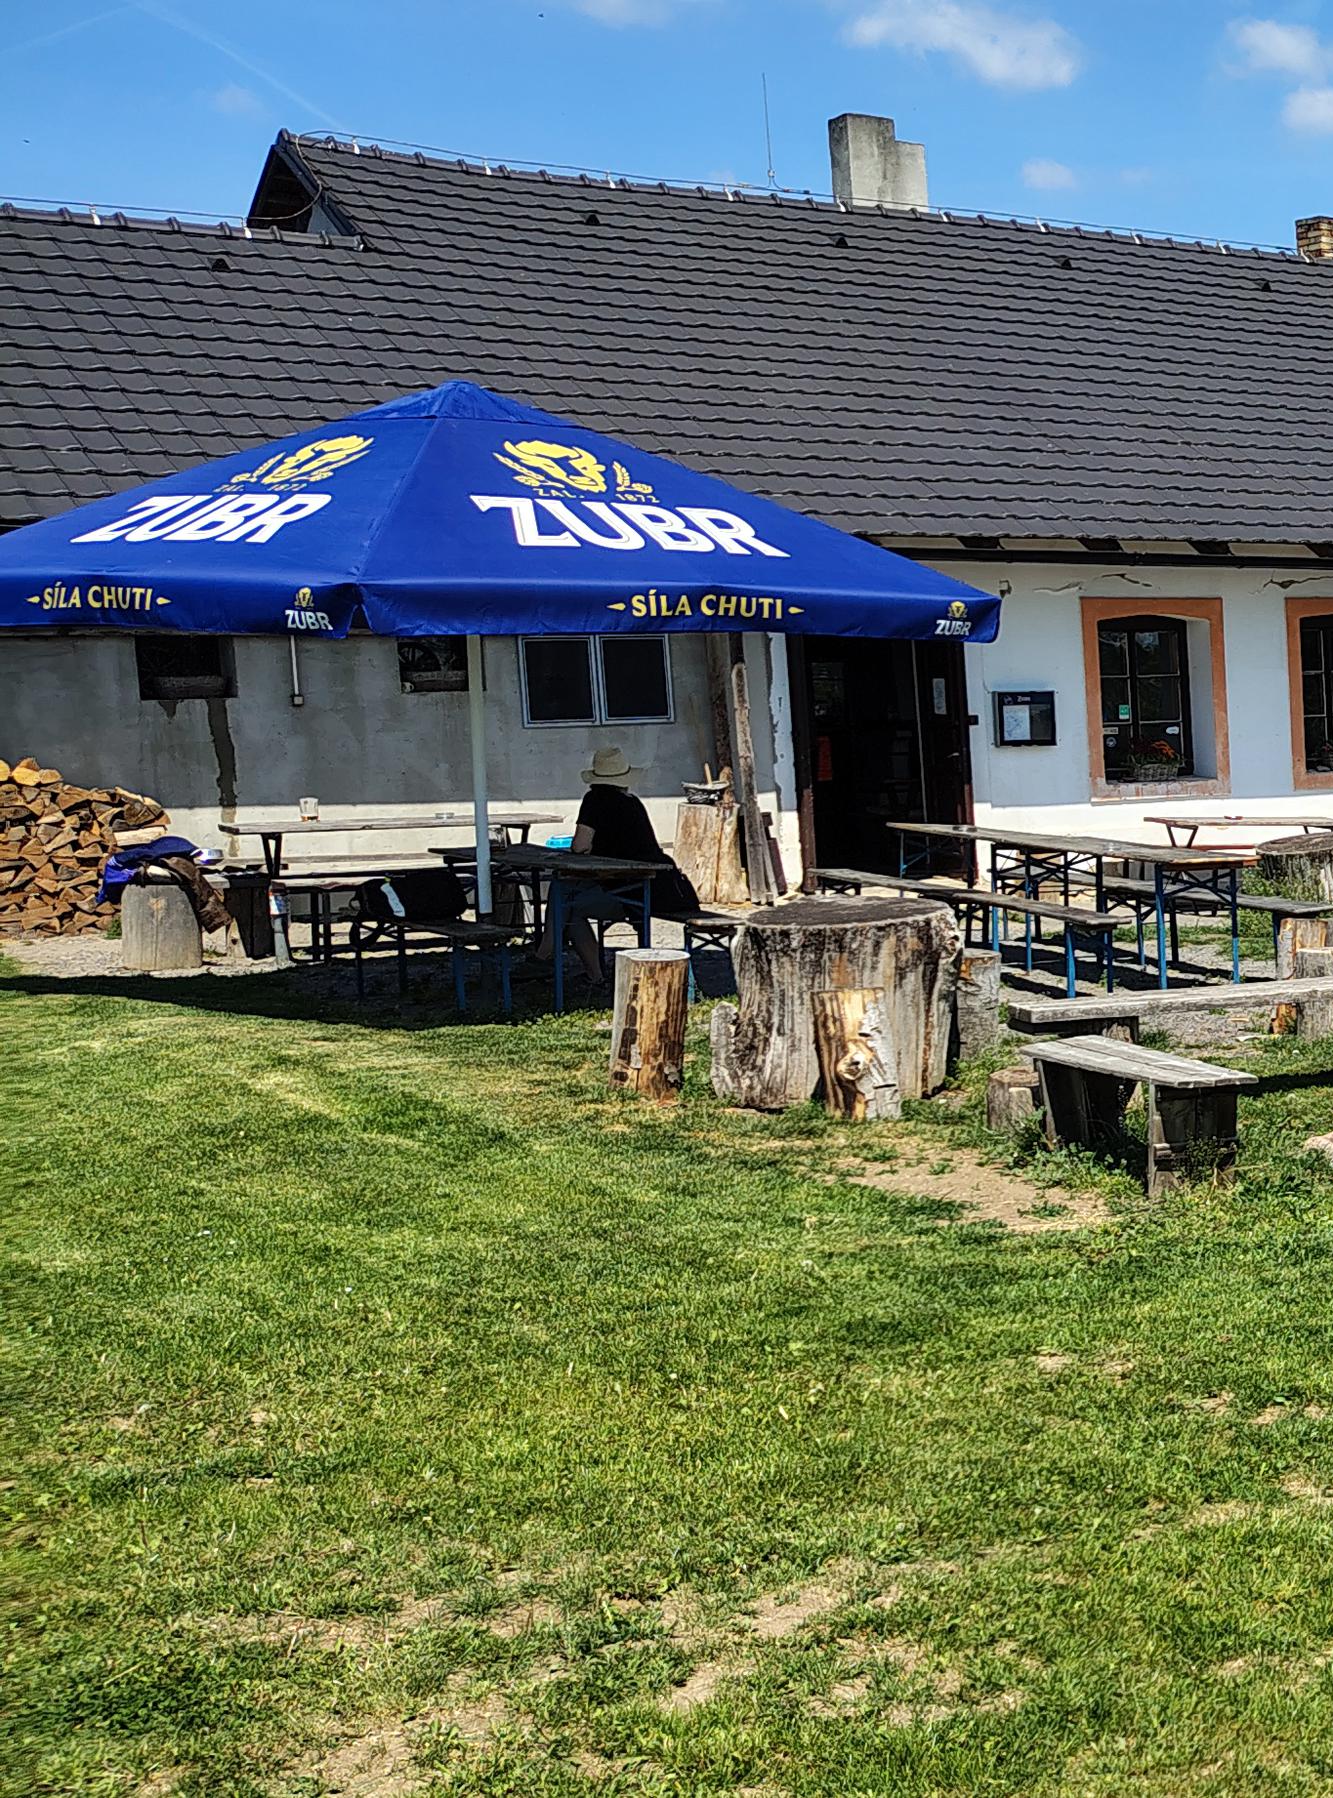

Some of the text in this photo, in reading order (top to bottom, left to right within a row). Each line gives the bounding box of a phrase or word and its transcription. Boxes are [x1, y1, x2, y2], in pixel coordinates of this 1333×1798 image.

[615, 493, 660, 503] 1872
[70, 494, 331, 543] ZUBR
[470, 495, 791, 558] ZUBR
[42, 581, 153, 611] SÍLA CHUTI
[631, 589, 783, 619] SÍLA CHUTI
[285, 609, 334, 631] ZUBR
[934, 619, 972, 637] ZUBR
